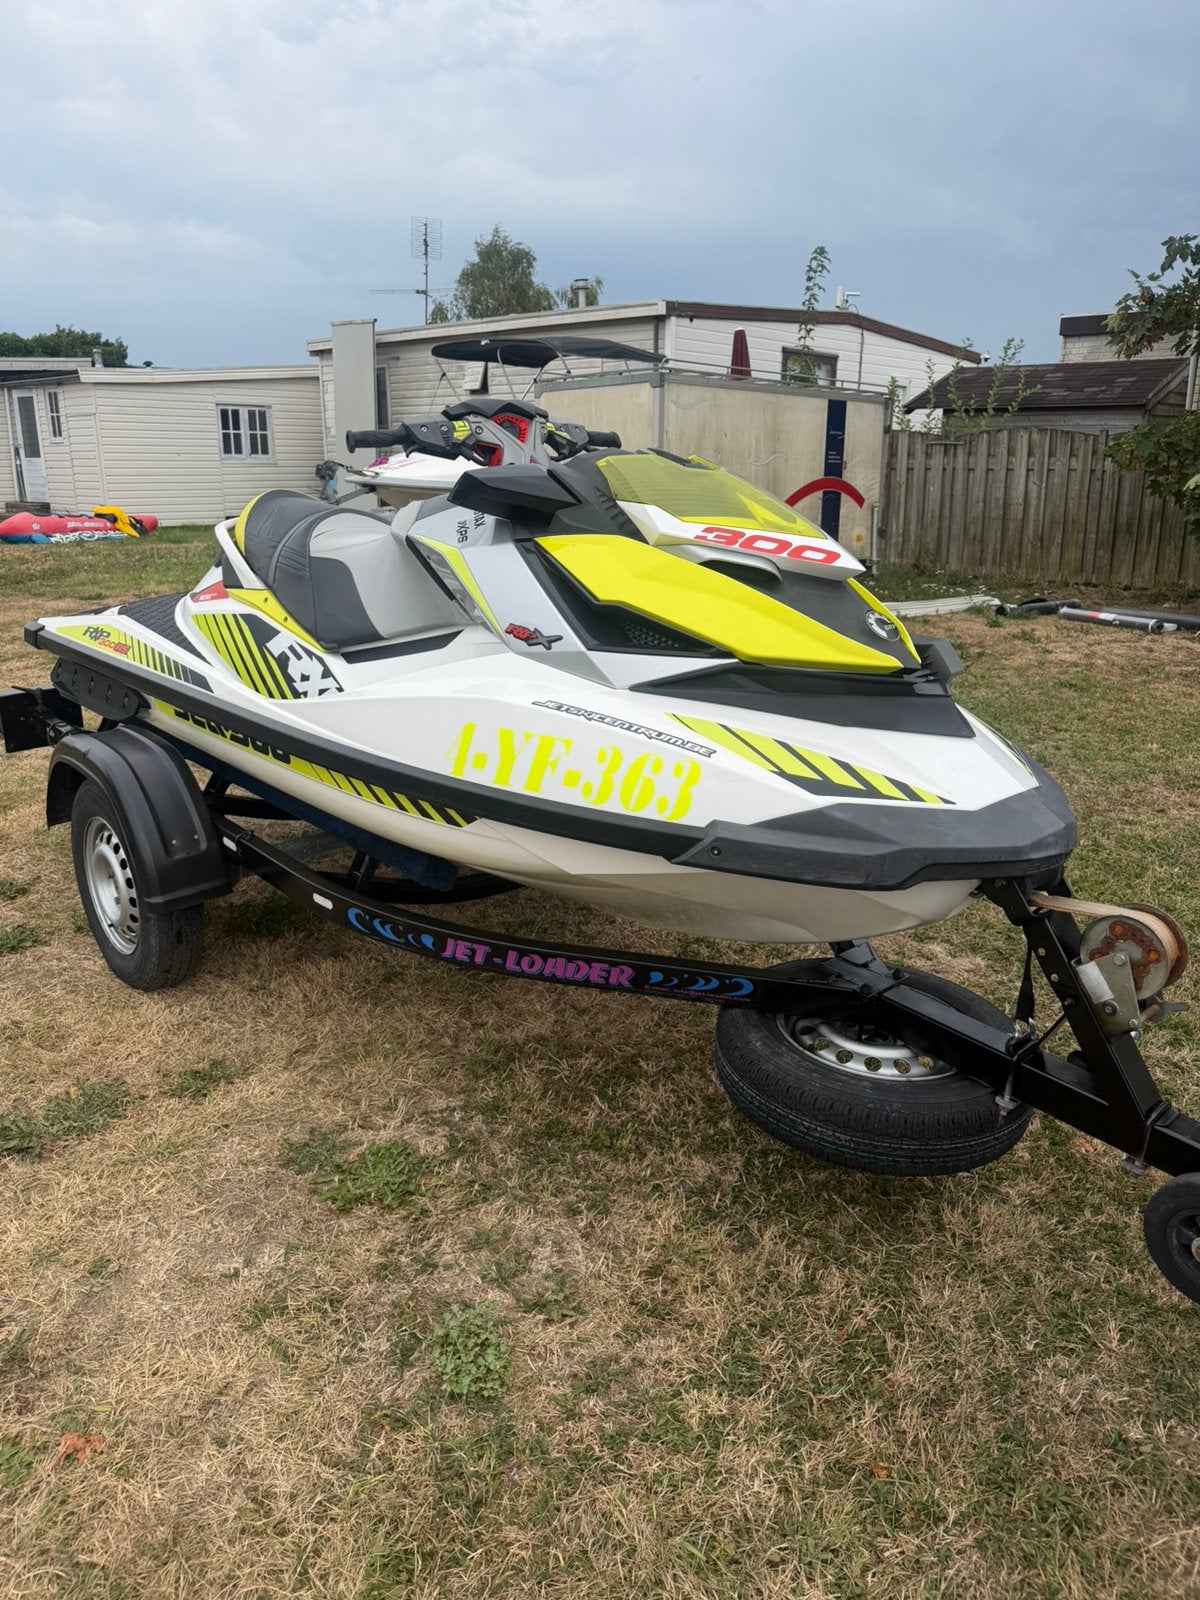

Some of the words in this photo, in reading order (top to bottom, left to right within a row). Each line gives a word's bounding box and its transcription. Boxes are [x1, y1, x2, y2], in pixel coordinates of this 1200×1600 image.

[693, 526, 842, 565] 300
[531, 700, 717, 758] JETSKICENTRUM.BE
[443, 722, 702, 823] 4-YF-363
